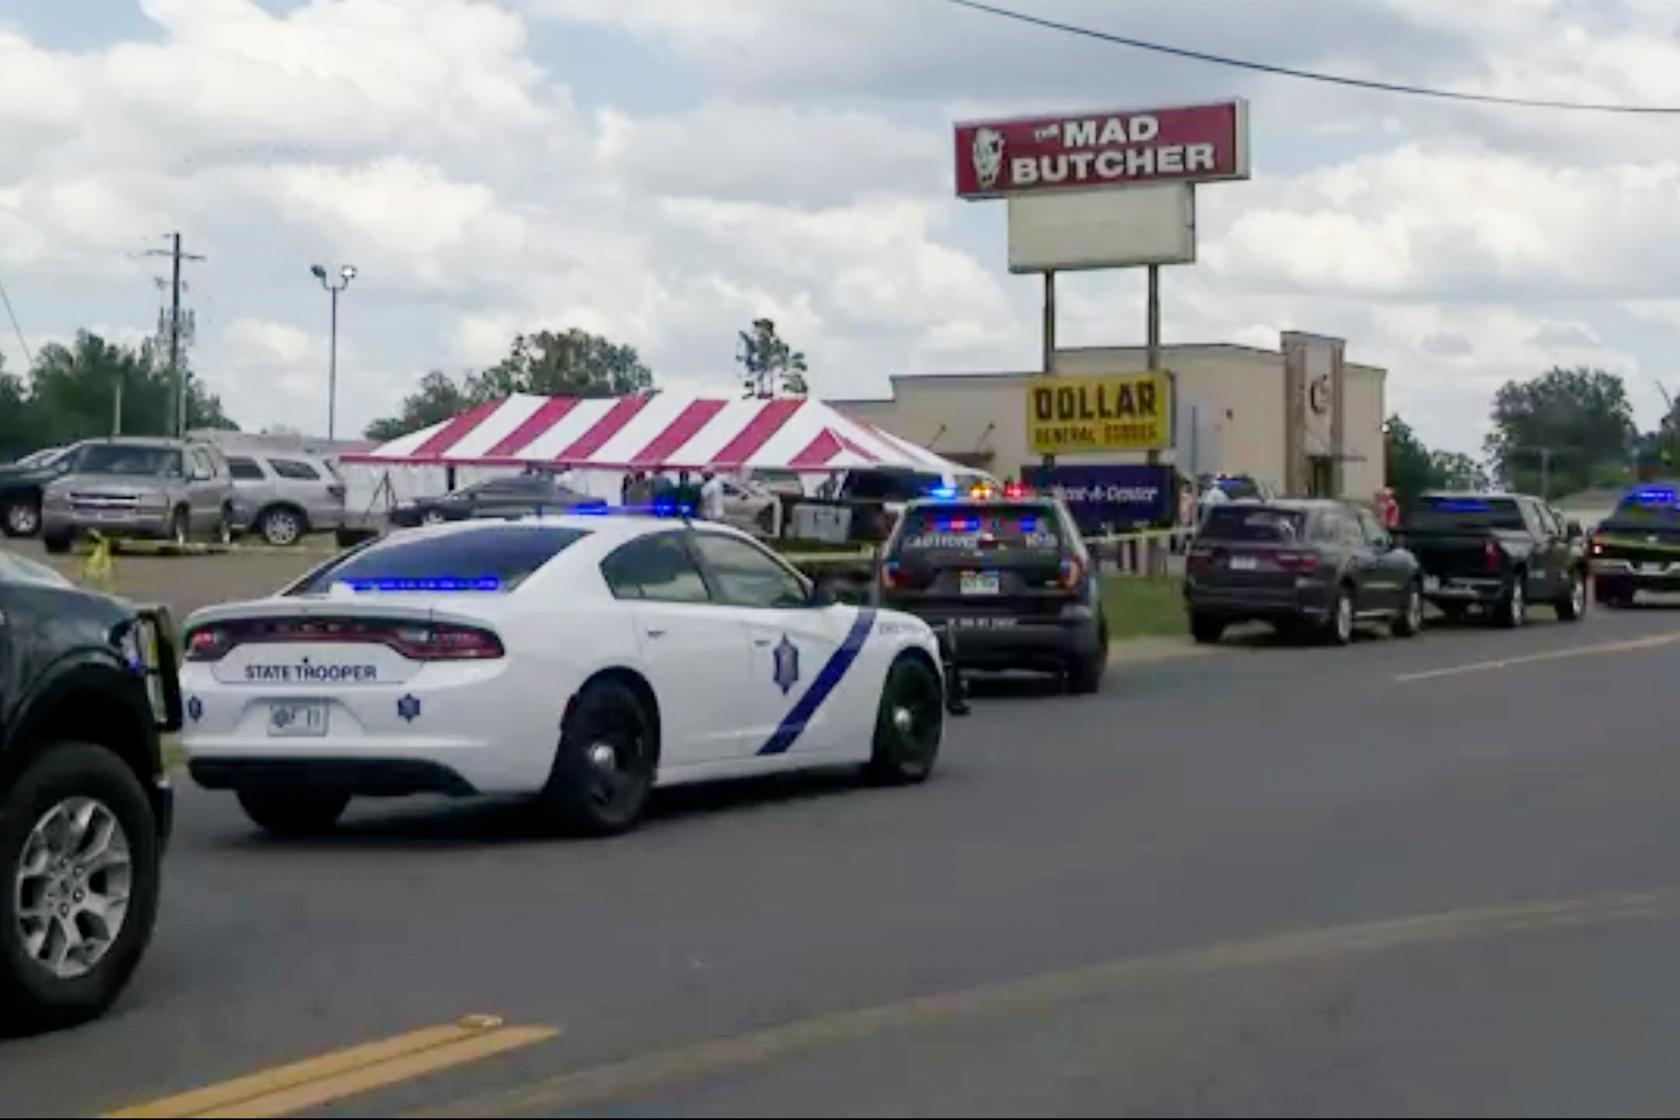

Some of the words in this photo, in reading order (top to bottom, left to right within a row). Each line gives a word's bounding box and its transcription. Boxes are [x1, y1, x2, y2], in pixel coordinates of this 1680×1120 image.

[1064, 116, 1158, 148] MAD
[1011, 144, 1214, 184] BUTCHER
[1034, 381, 1157, 421] DOLLAR
[245, 665, 289, 680] STATE
[294, 664, 377, 680] TROOPER
